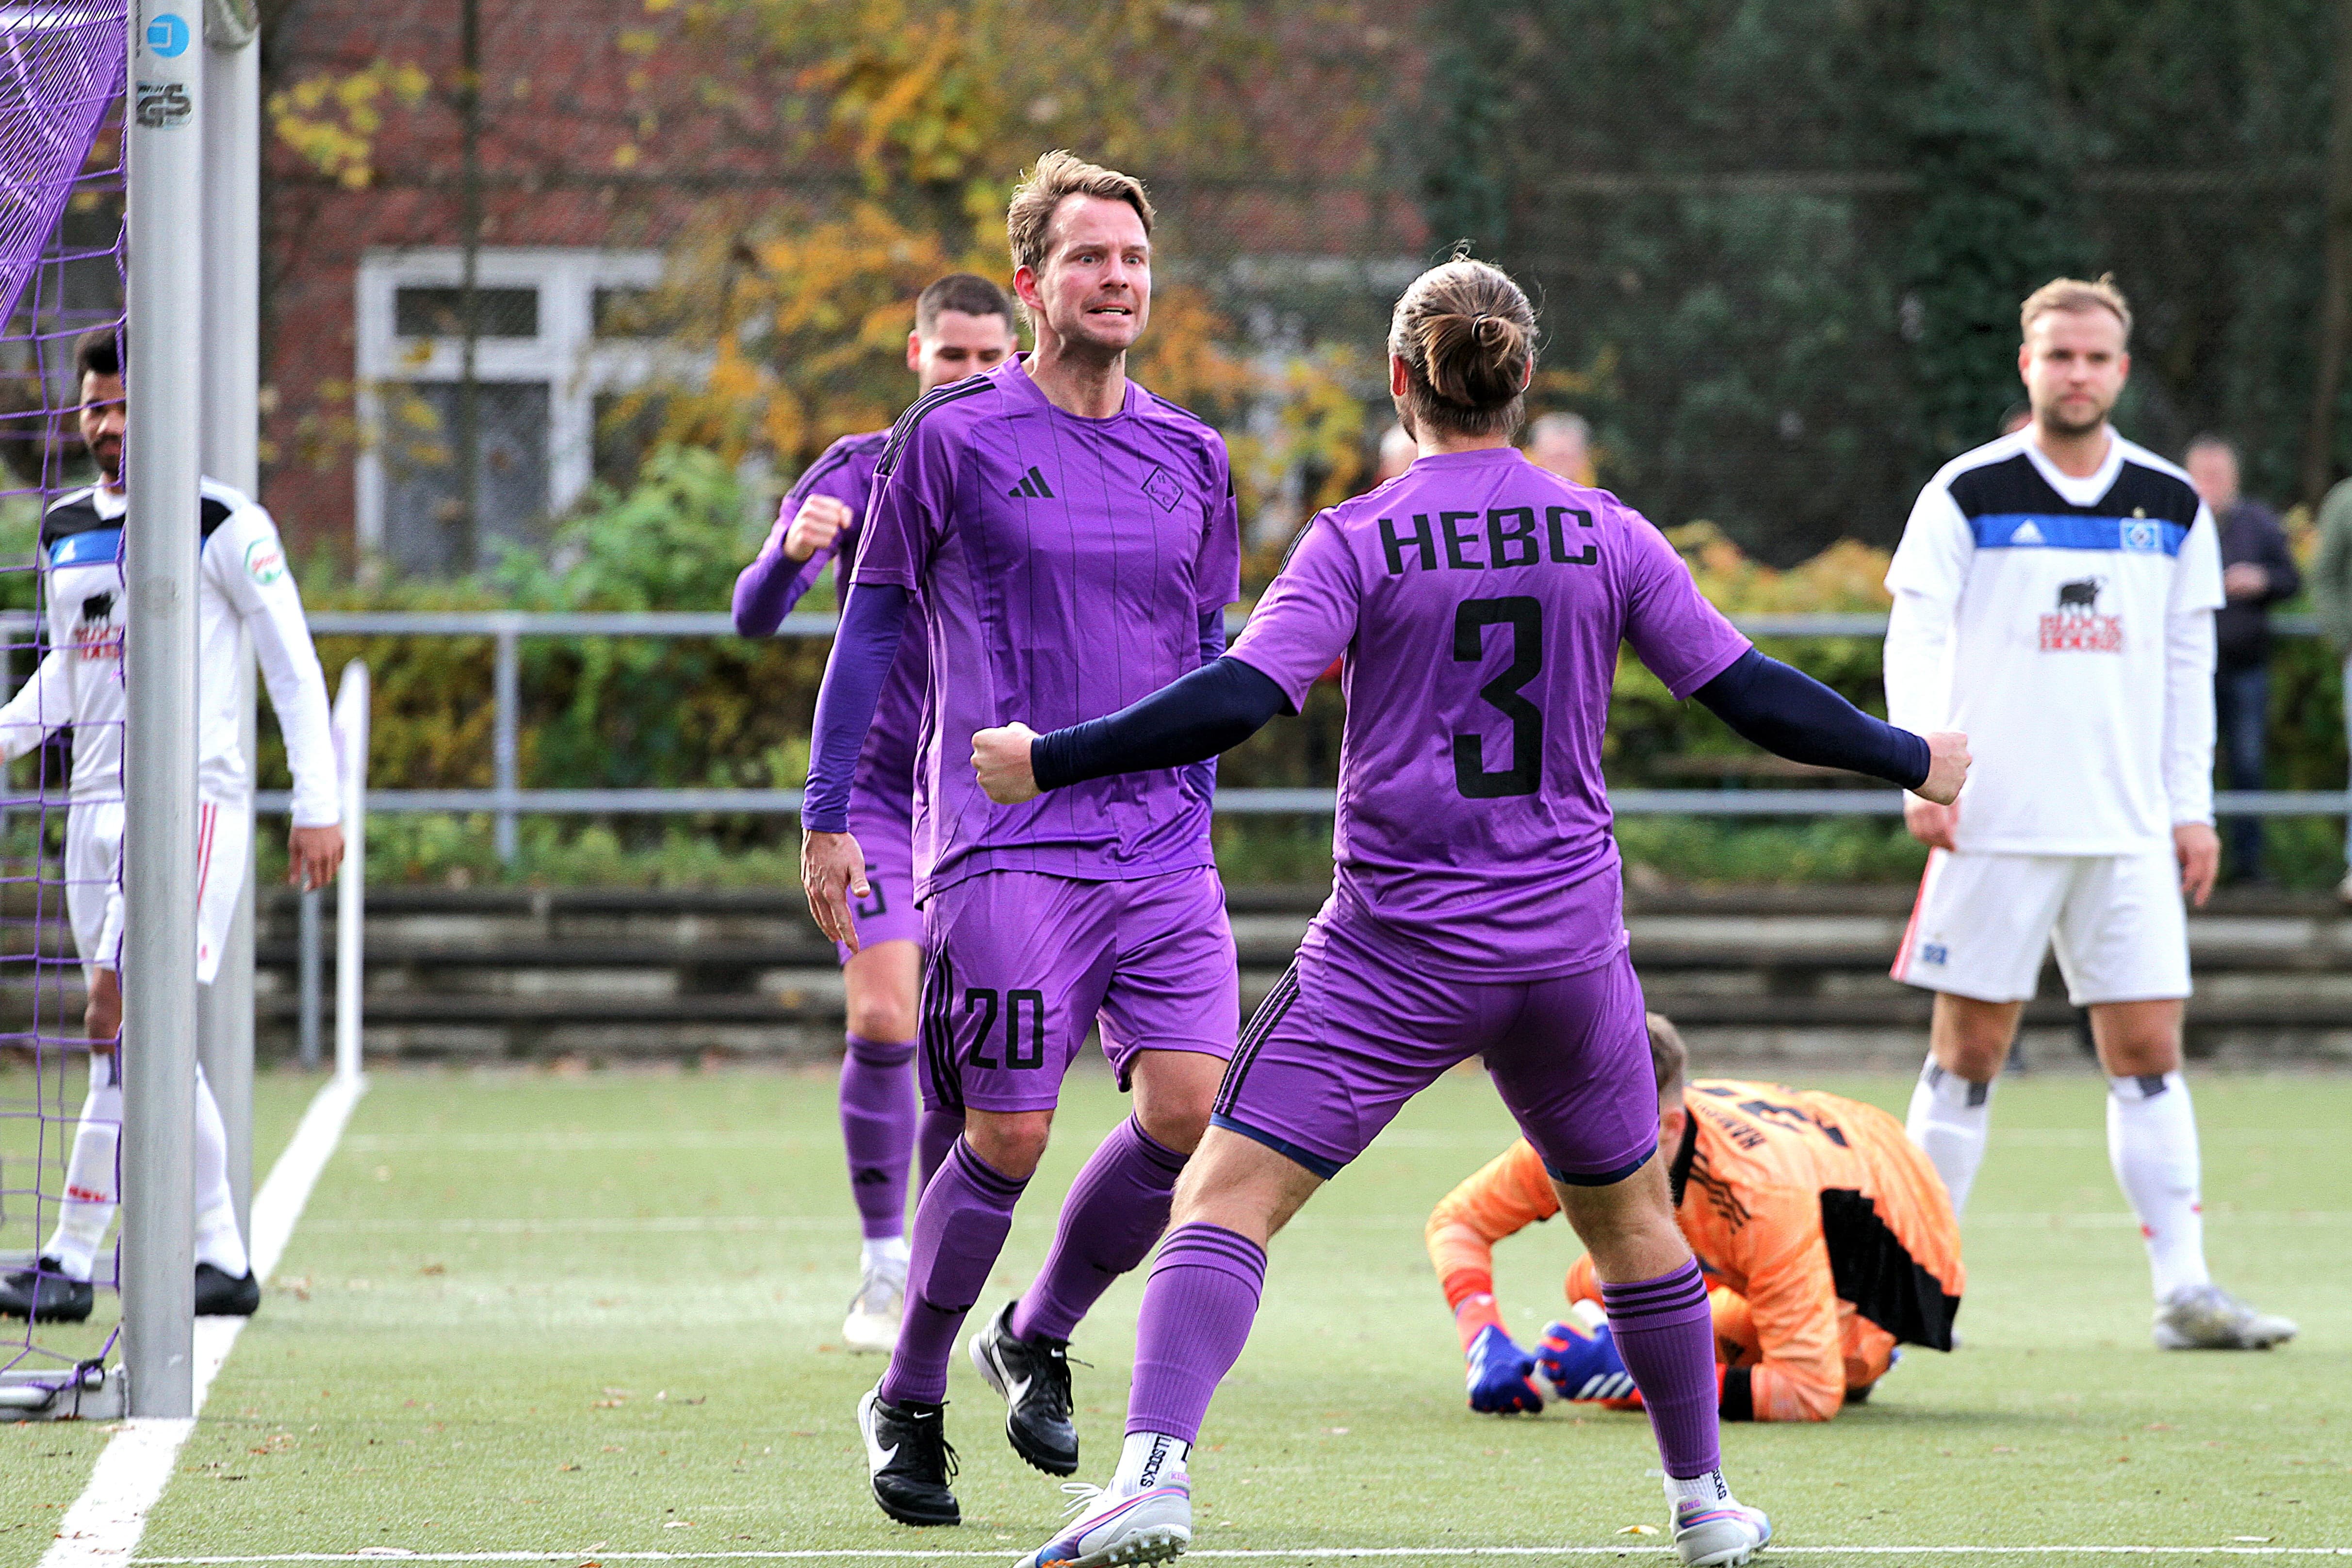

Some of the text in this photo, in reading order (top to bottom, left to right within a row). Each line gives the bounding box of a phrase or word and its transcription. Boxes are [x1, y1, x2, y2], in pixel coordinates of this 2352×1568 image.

[1379, 506, 1597, 574] HEBC
[1453, 595, 1543, 799] 3
[965, 988, 1044, 1070] 20
